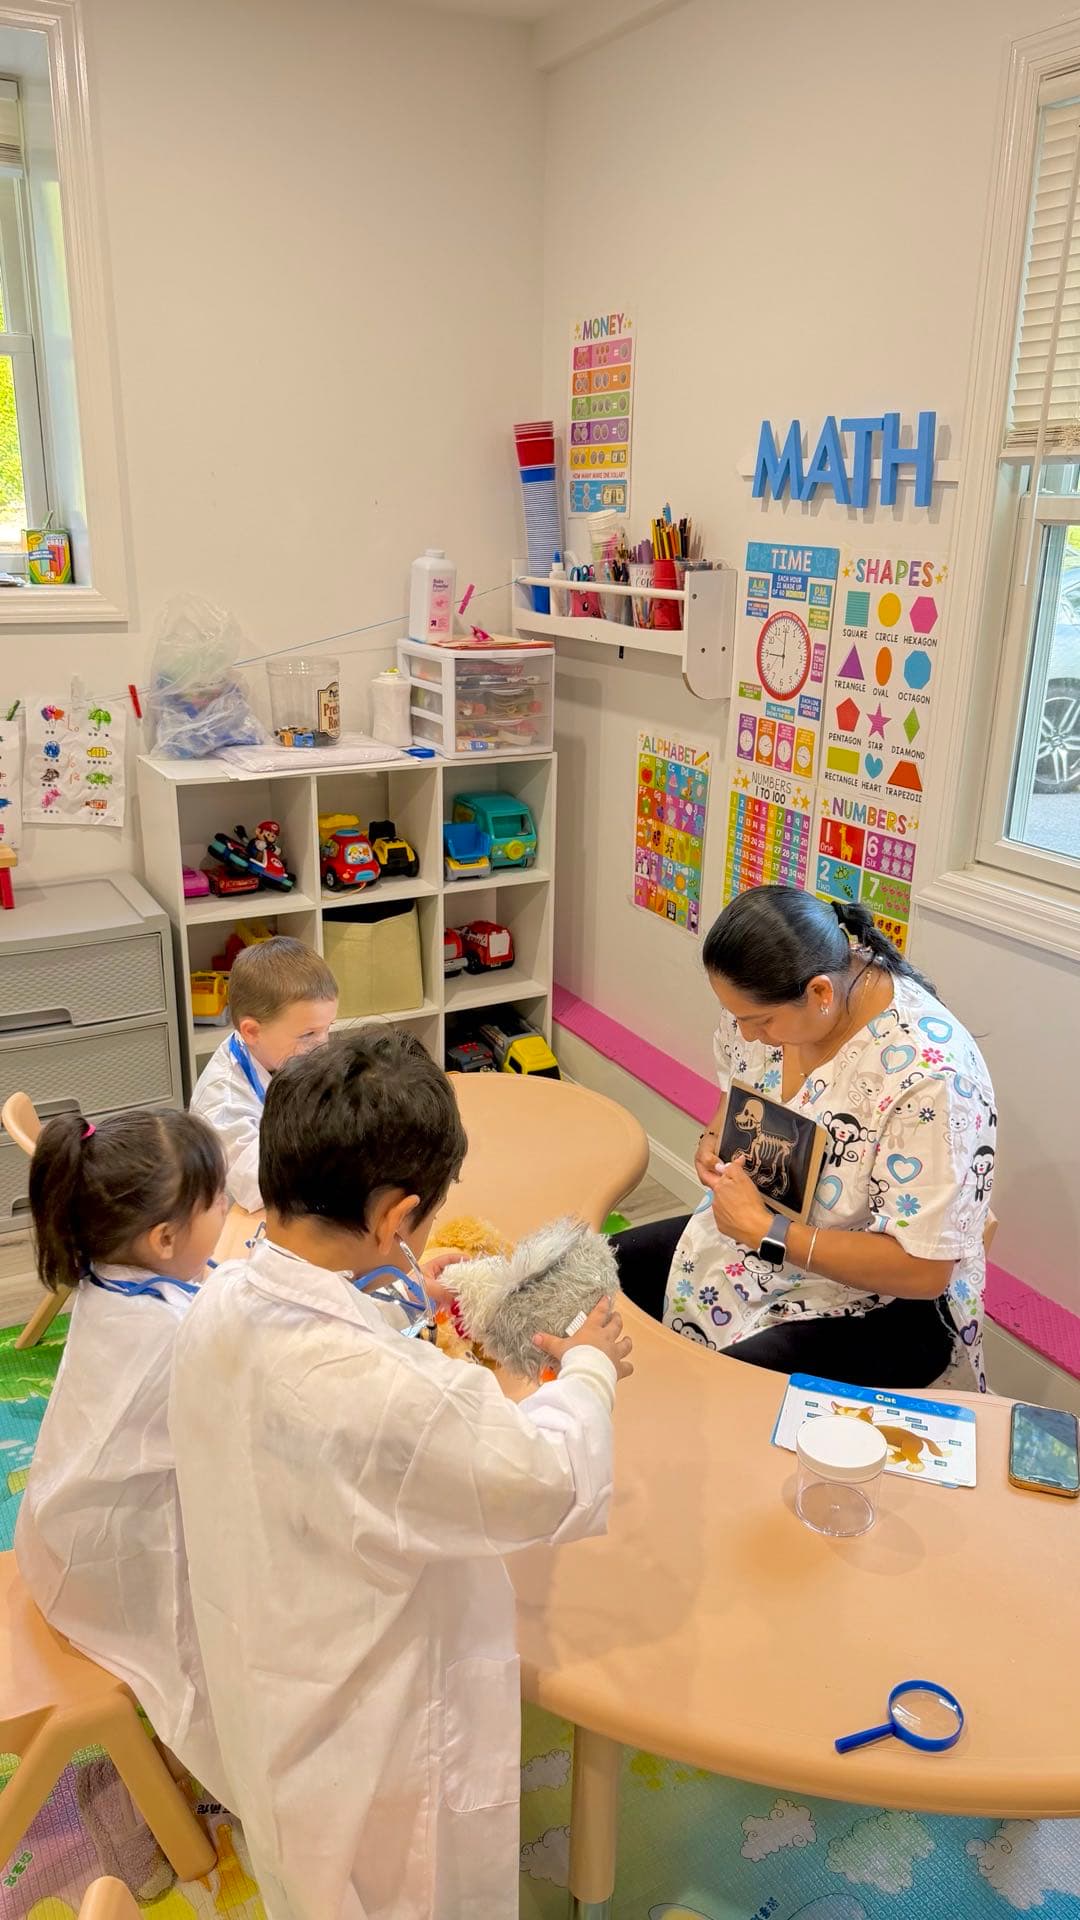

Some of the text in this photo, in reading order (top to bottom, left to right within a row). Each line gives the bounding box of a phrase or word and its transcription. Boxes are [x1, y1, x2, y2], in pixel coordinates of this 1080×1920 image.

[583, 313, 625, 341] MONEY
[752, 412, 936, 508] MATH
[771, 549, 813, 572] TIME
[855, 558, 935, 587] SHAPES
[842, 628, 868, 639] SQUARE
[875, 632, 899, 643] CIRCLE
[903, 636, 937, 647] HEXAGON
[834, 680, 866, 692] TRIANGLE
[873, 688, 889, 698] OVAL
[898, 692, 931, 704] OCTAGON
[828, 732, 861, 746] PENTAGON
[868, 741, 883, 751] STAR
[642, 736, 697, 766] ALPHABET
[891, 746, 925, 760] DIAMOND
[751, 771, 791, 794] NUMBERS
[824, 771, 858, 787] RECTANGLE
[861, 781, 881, 793] HEART
[755, 786, 786, 804] 1 TO 100
[778, 812, 783, 820] 7
[787, 815, 792, 823] 8
[795, 817, 800, 826] 9
[803, 820, 809, 829] 10
[833, 797, 907, 835] NUMBERS
[825, 821, 832, 842] 1
[801, 837, 808, 846] 20
[820, 842, 834, 854] One
[867, 835, 879, 857] 6
[758, 839, 765, 848] 25
[774, 846, 781, 854] 27
[782, 848, 790, 858] 28
[790, 851, 798, 860] 29
[799, 855, 806, 864] 30
[866, 856, 877, 868] Six
[788, 869, 796, 878] 39
[819, 860, 830, 882] 2
[817, 879, 831, 892] Two
[869, 876, 880, 897] 7
[875, 1394, 896, 1404] Cat
